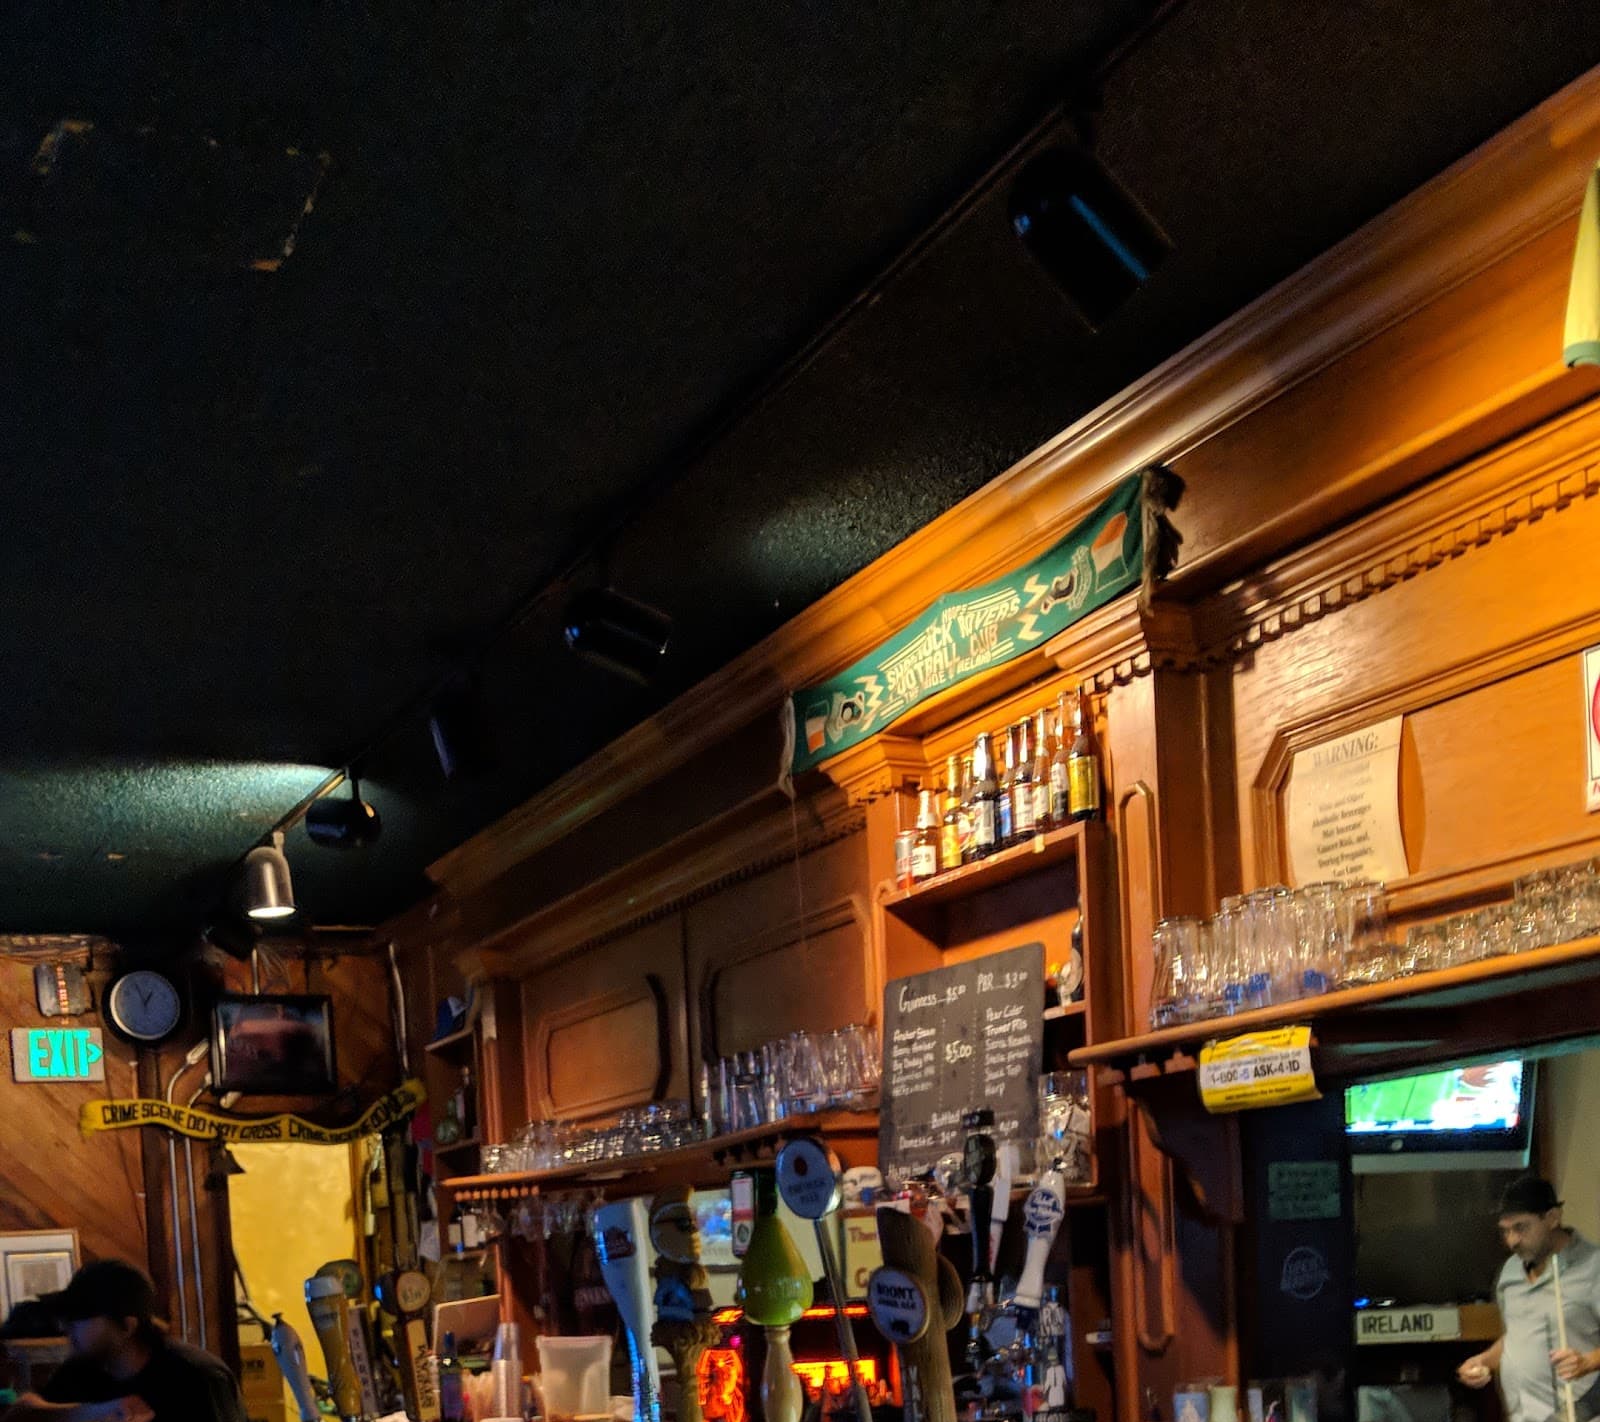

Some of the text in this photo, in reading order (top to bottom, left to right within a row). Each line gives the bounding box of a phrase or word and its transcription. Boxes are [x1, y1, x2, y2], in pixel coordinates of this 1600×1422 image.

[886, 619, 953, 691] SHAOCK
[957, 597, 1021, 638] ROVERS
[1312, 732, 1379, 768] WARNING:
[29, 1029, 91, 1078] EXIT
[102, 1104, 139, 1124] CRIME
[142, 1102, 185, 1129] SCENE
[186, 1114, 207, 1132] DO
[207, 1120, 237, 1139] NOT
[240, 1120, 282, 1139] CROSS
[1362, 1313, 1434, 1334] IRELAND
